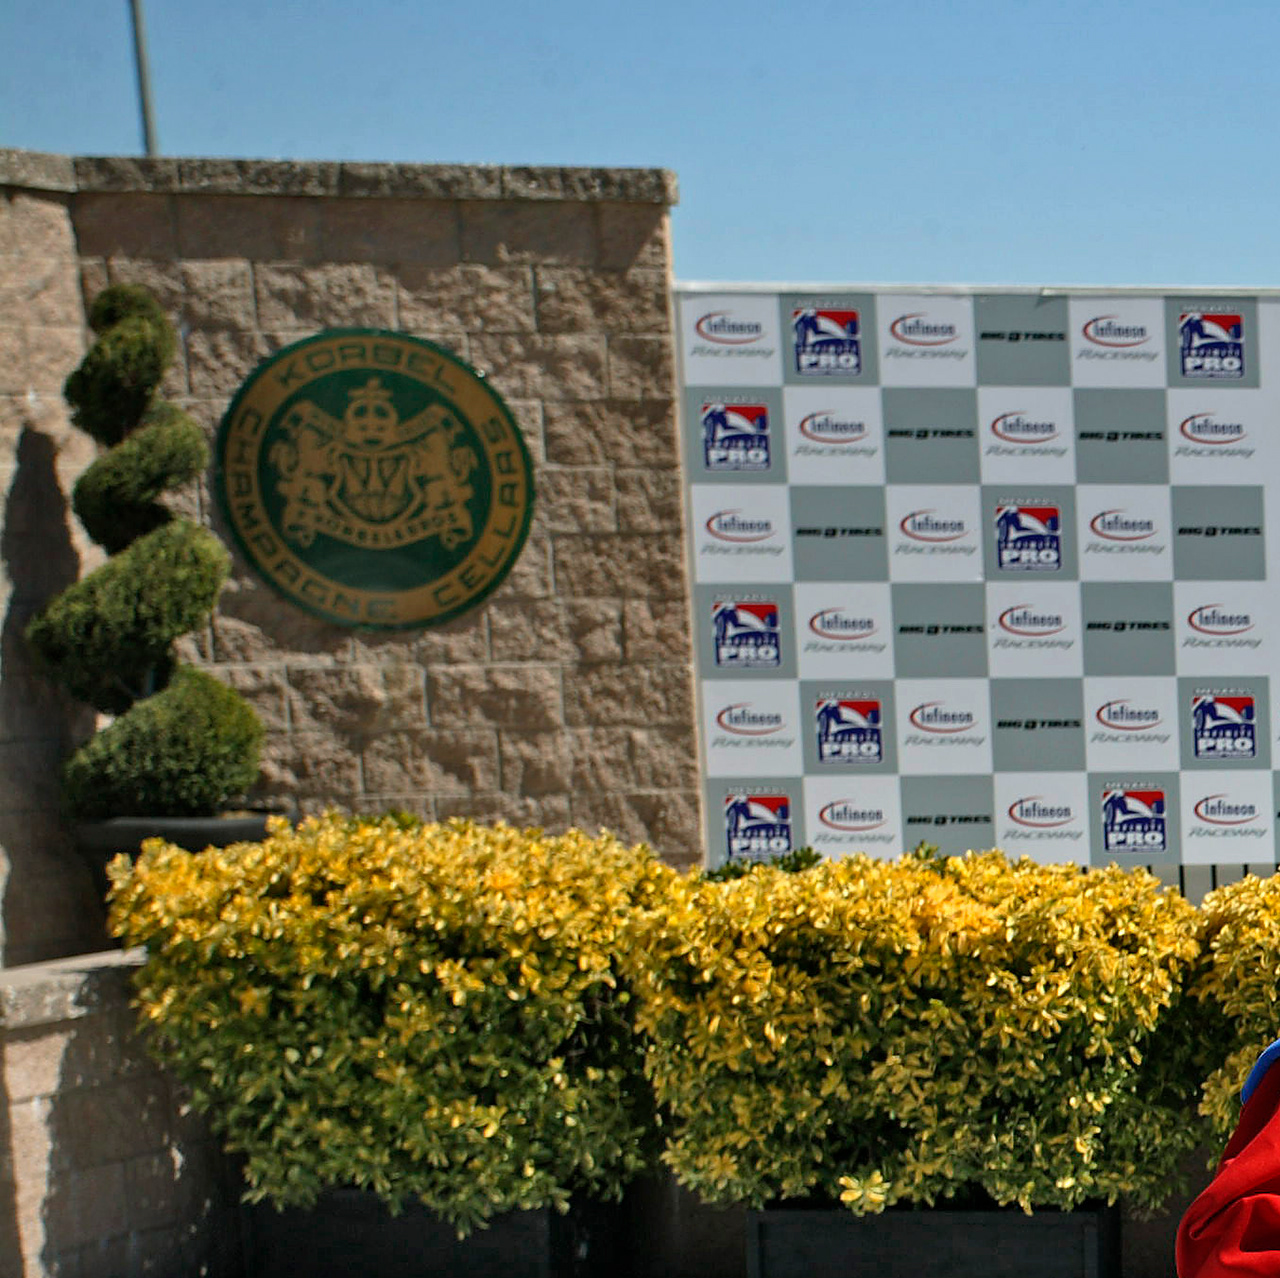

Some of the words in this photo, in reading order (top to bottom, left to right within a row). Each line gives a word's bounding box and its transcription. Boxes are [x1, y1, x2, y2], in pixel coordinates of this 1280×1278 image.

[1025, 332, 1066, 342] TIRES
[799, 353, 859, 368] PRO
[1184, 357, 1242, 371] PRO
[273, 343, 456, 397] KORBEL
[708, 448, 768, 463] PRO
[1001, 549, 1059, 563] PRO
[719, 646, 777, 660] PRO
[822, 742, 880, 756] PRO
[1196, 737, 1253, 752] PRO
[731, 838, 789, 852] PRO
[1107, 831, 1164, 846] PRO
